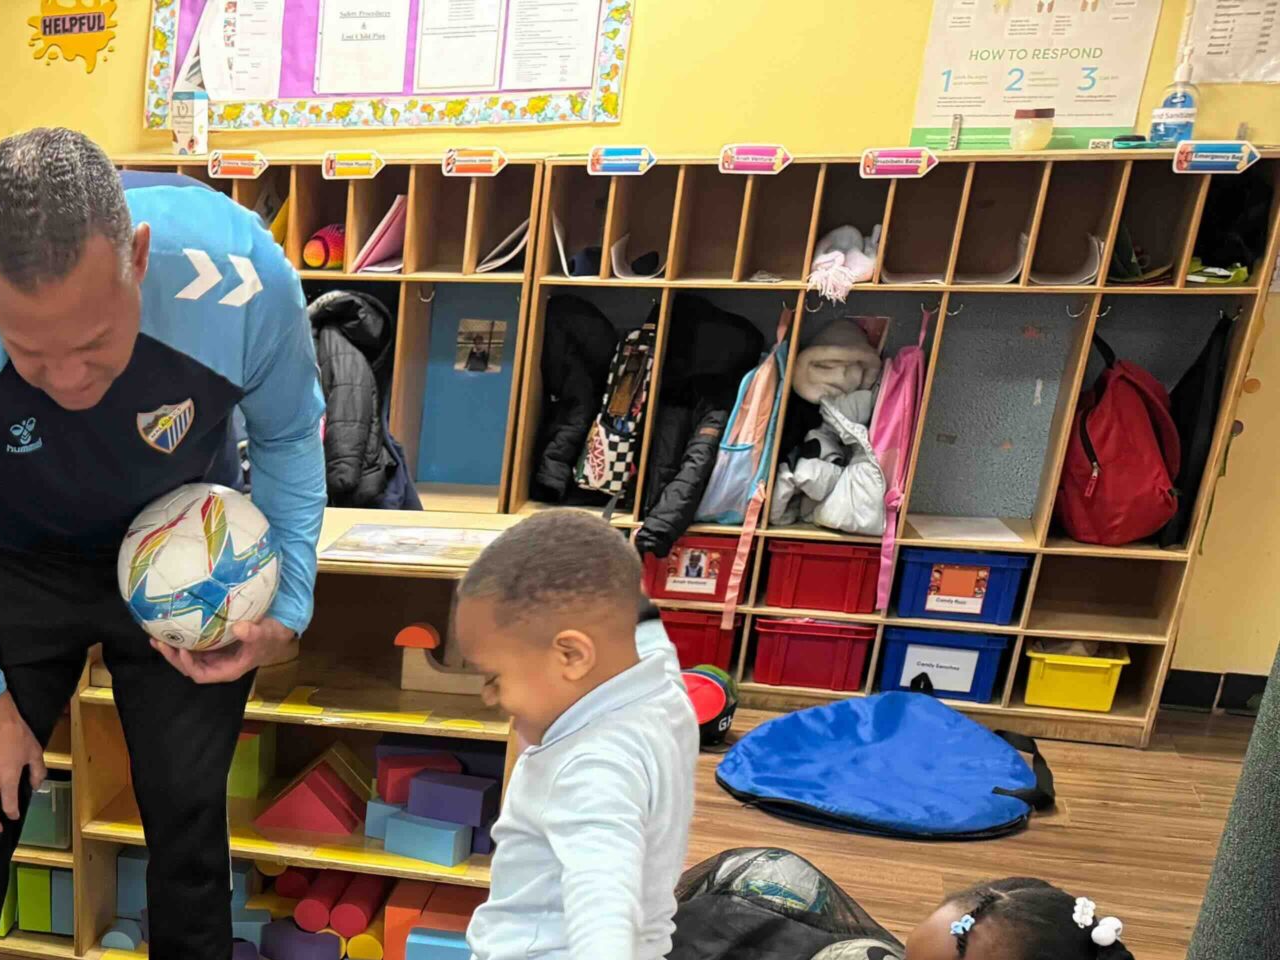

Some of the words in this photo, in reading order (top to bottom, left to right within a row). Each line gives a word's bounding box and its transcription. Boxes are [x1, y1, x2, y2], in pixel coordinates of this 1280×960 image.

[43, 14, 105, 35] HELPFUL
[968, 49, 1007, 61] HOW
[1009, 49, 1029, 60] TO
[1031, 48, 1104, 60] RESPOND
[941, 69, 952, 92] 1
[1005, 68, 1025, 92] 2
[1077, 67, 1099, 91] 3
